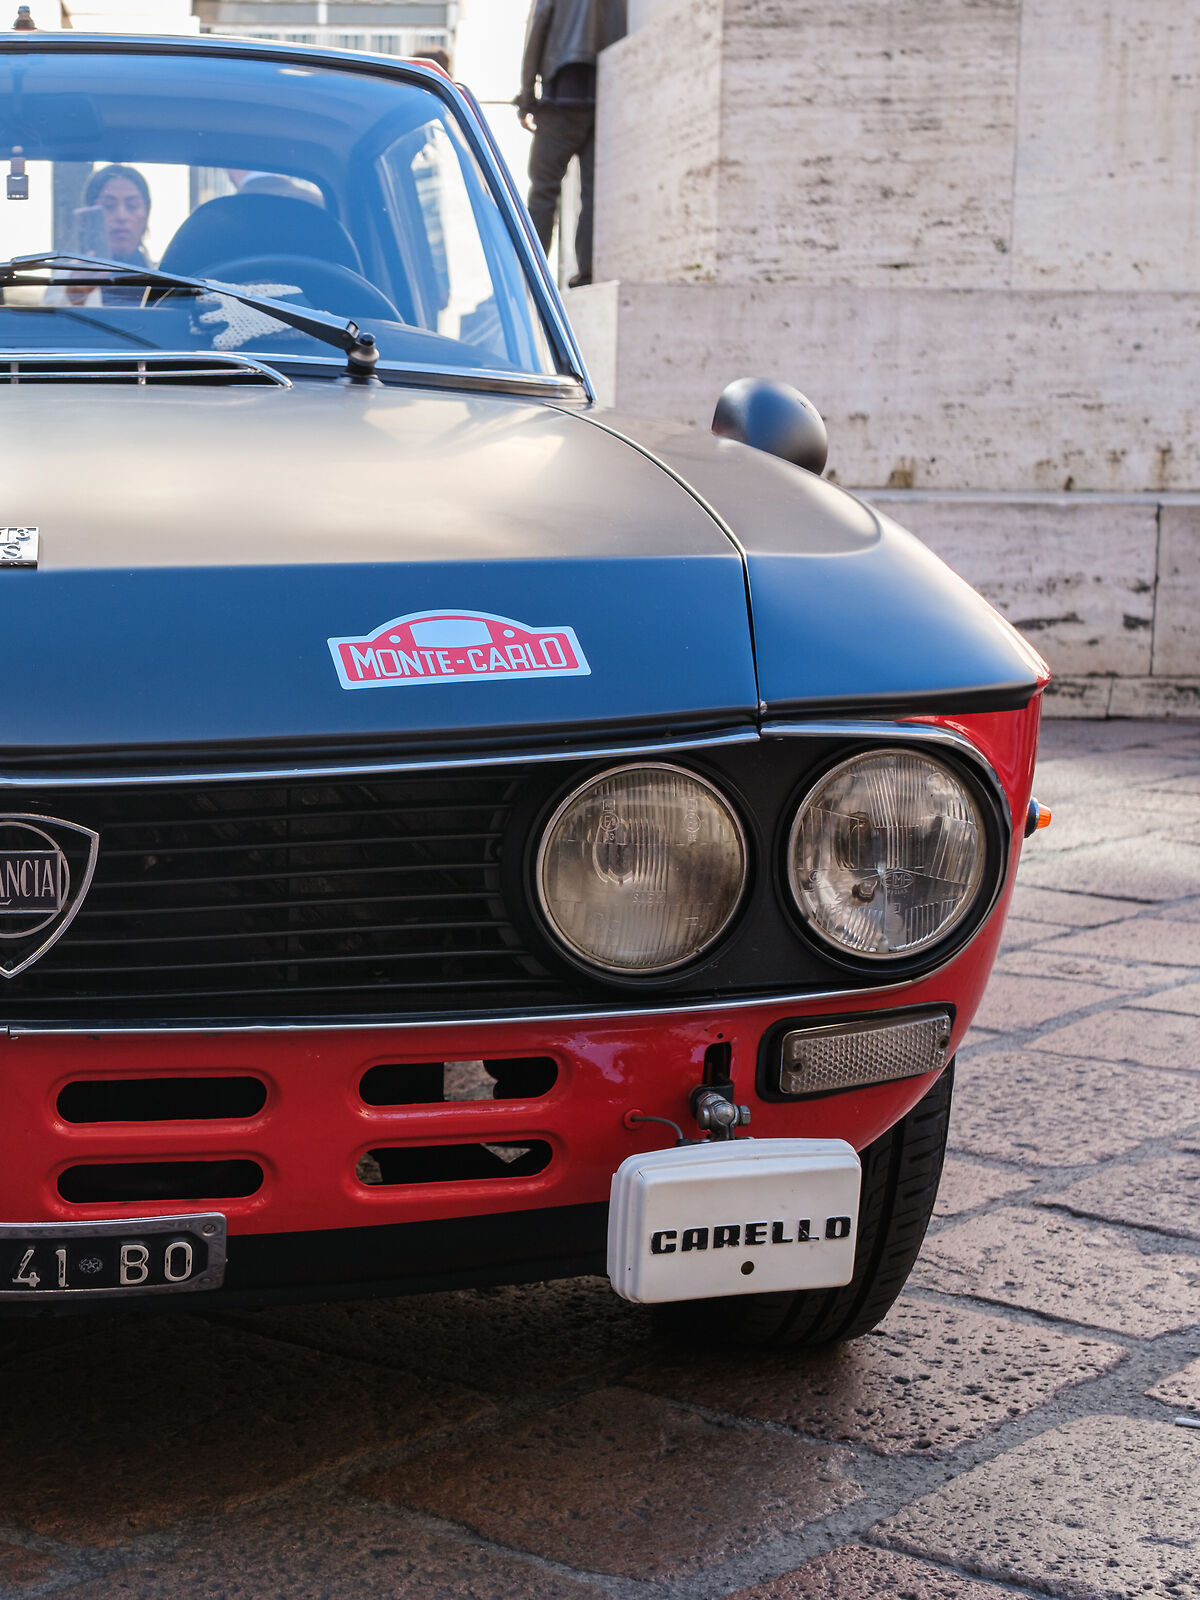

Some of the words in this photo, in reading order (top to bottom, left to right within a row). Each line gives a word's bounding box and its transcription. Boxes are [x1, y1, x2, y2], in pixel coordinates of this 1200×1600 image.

[349, 637, 568, 679] MONTE-CARLO
[651, 1215, 851, 1255] CARELLO
[119, 1241, 193, 1285] BO
